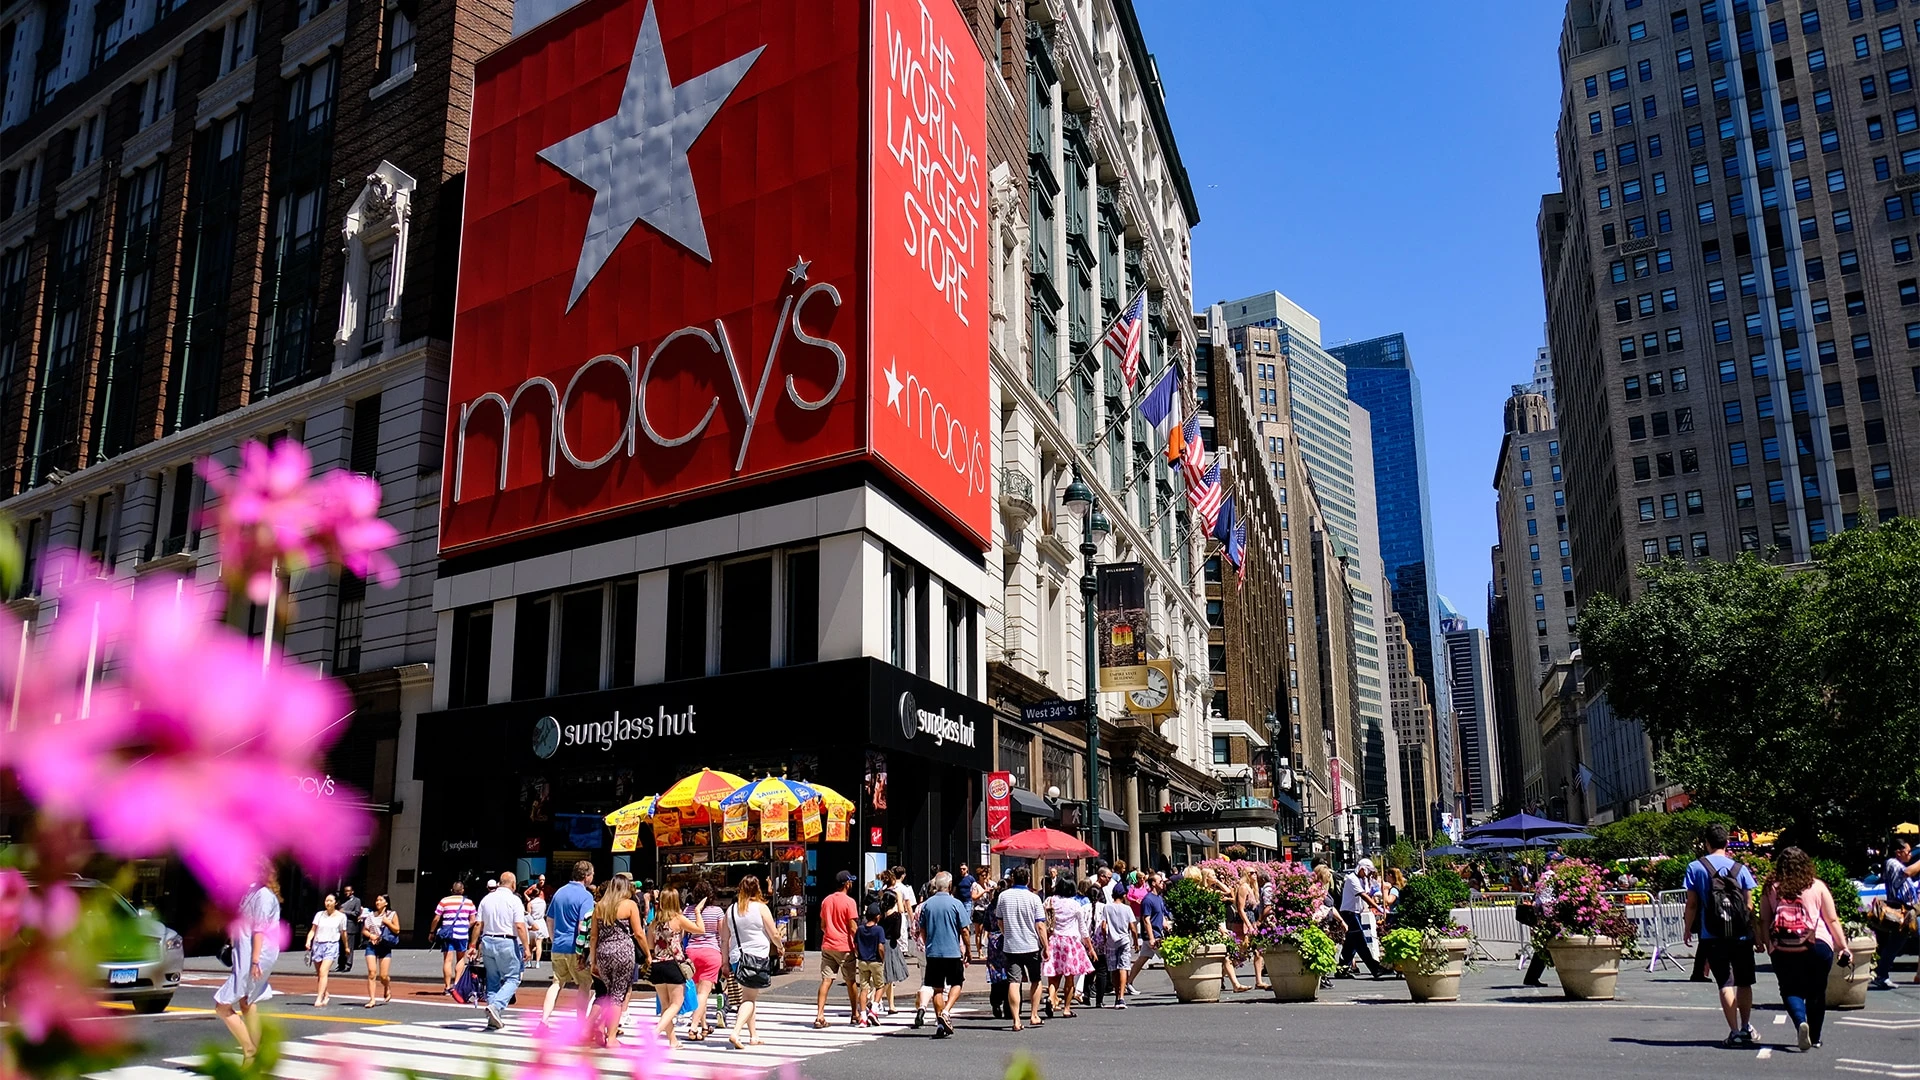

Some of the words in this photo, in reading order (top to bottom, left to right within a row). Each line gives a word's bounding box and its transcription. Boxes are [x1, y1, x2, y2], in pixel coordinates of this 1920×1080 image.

[886, 10, 980, 209] WORLD'S
[917, 0, 956, 110] THE
[887, 86, 979, 268] LARGEST
[904, 191, 969, 327] STORE
[454, 255, 847, 502] macy's
[906, 371, 984, 497] macy's
[564, 710, 654, 751] sunglass
[658, 705, 697, 736] hut
[917, 707, 959, 747] sunglass
[959, 714, 976, 748] hut
[1026, 708, 1048, 719] West
[1050, 706, 1066, 718] 34th
[1067, 705, 1077, 716] St
